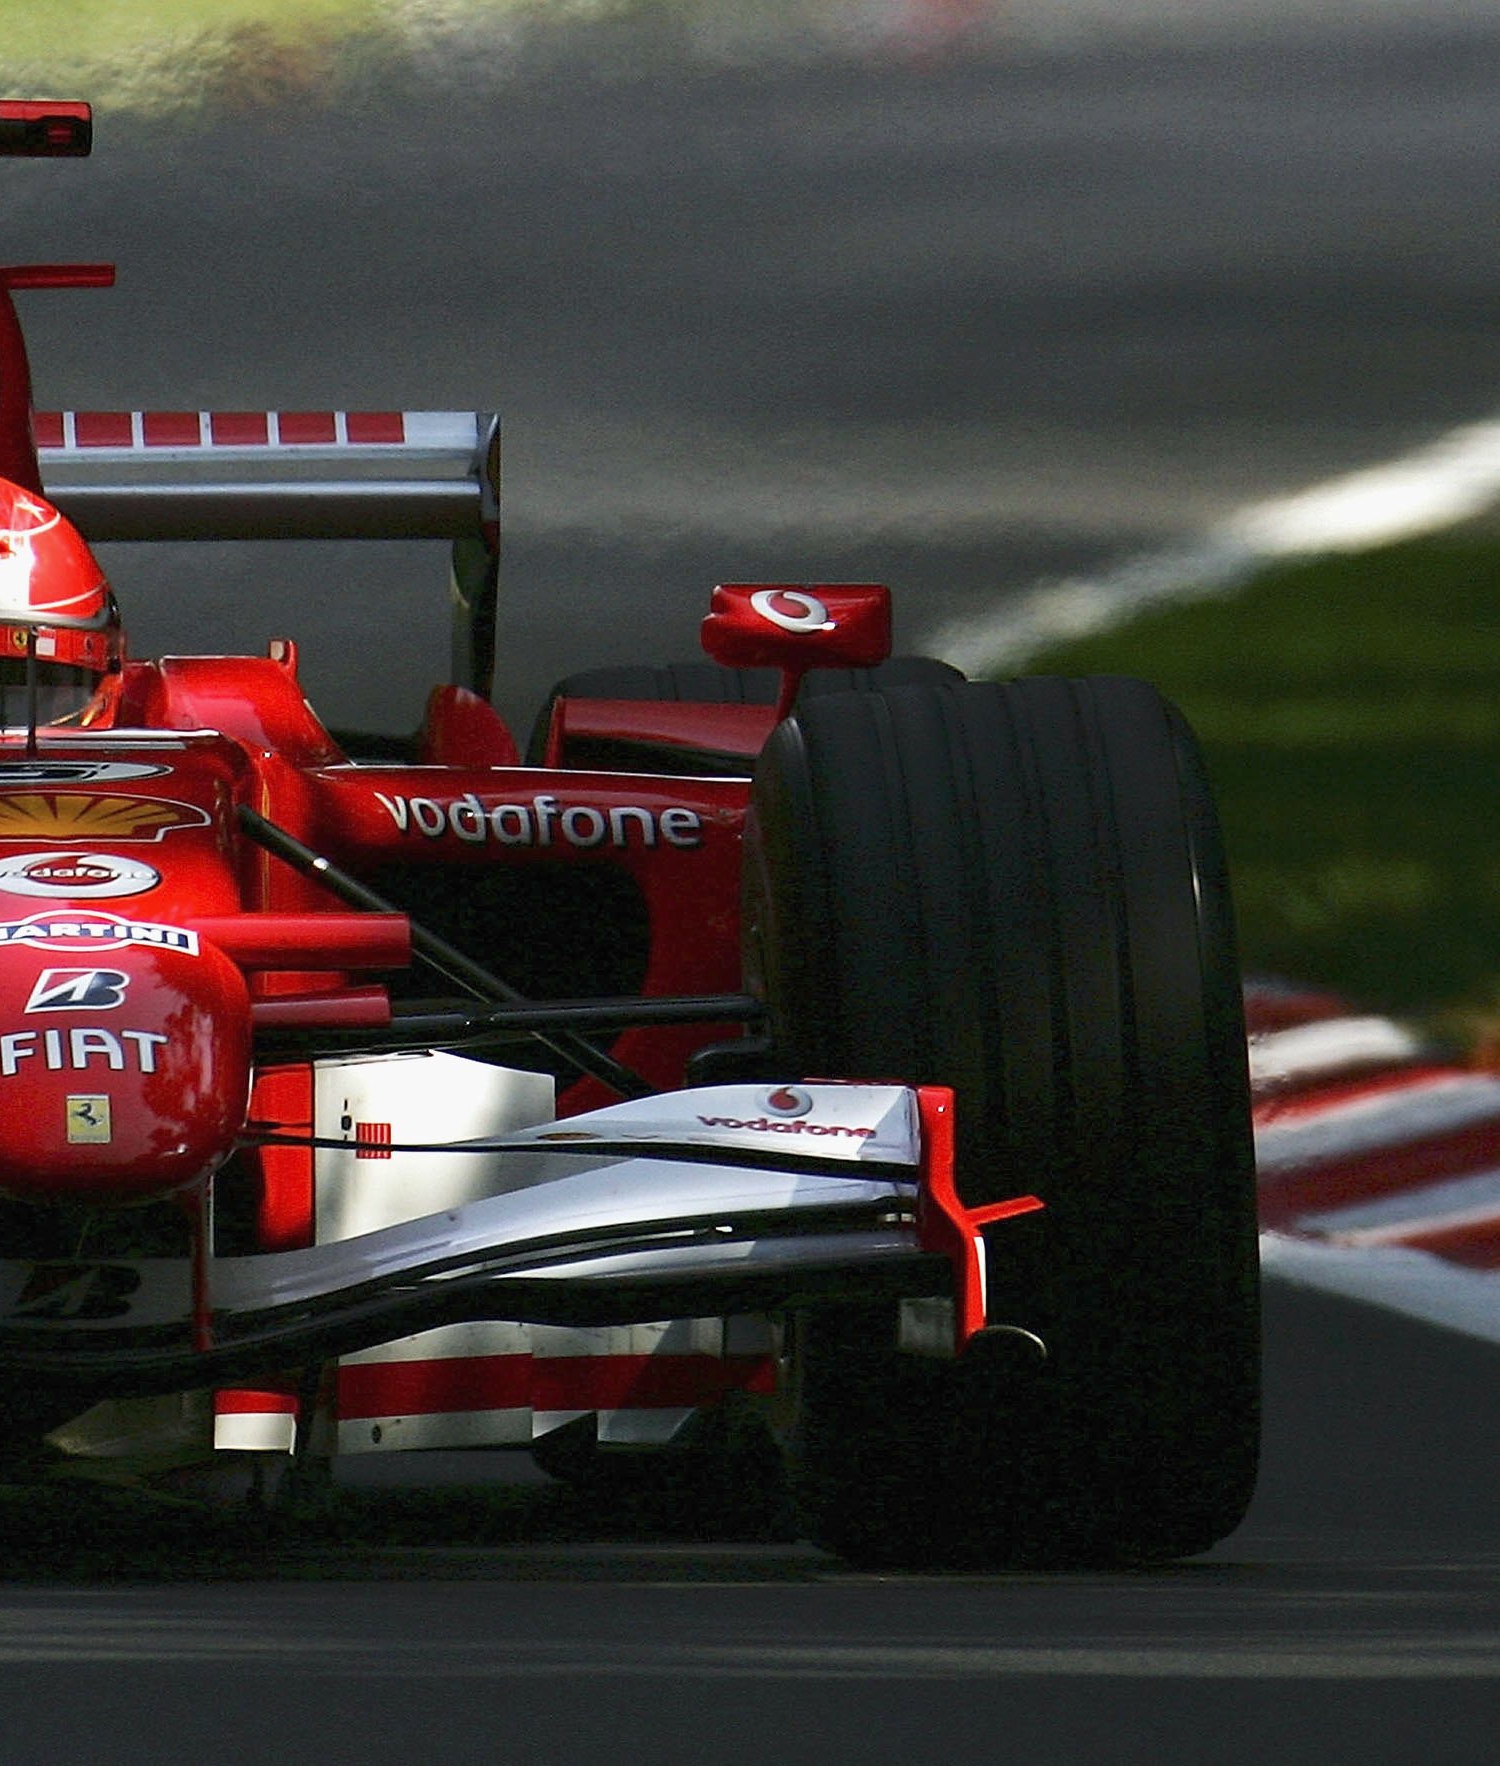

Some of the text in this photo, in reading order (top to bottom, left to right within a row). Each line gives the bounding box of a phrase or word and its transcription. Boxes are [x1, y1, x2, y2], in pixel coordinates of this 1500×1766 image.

[373, 793, 701, 847] vodafone
[0, 1028, 169, 1076] FIAT
[697, 1115, 877, 1139] vodafone
